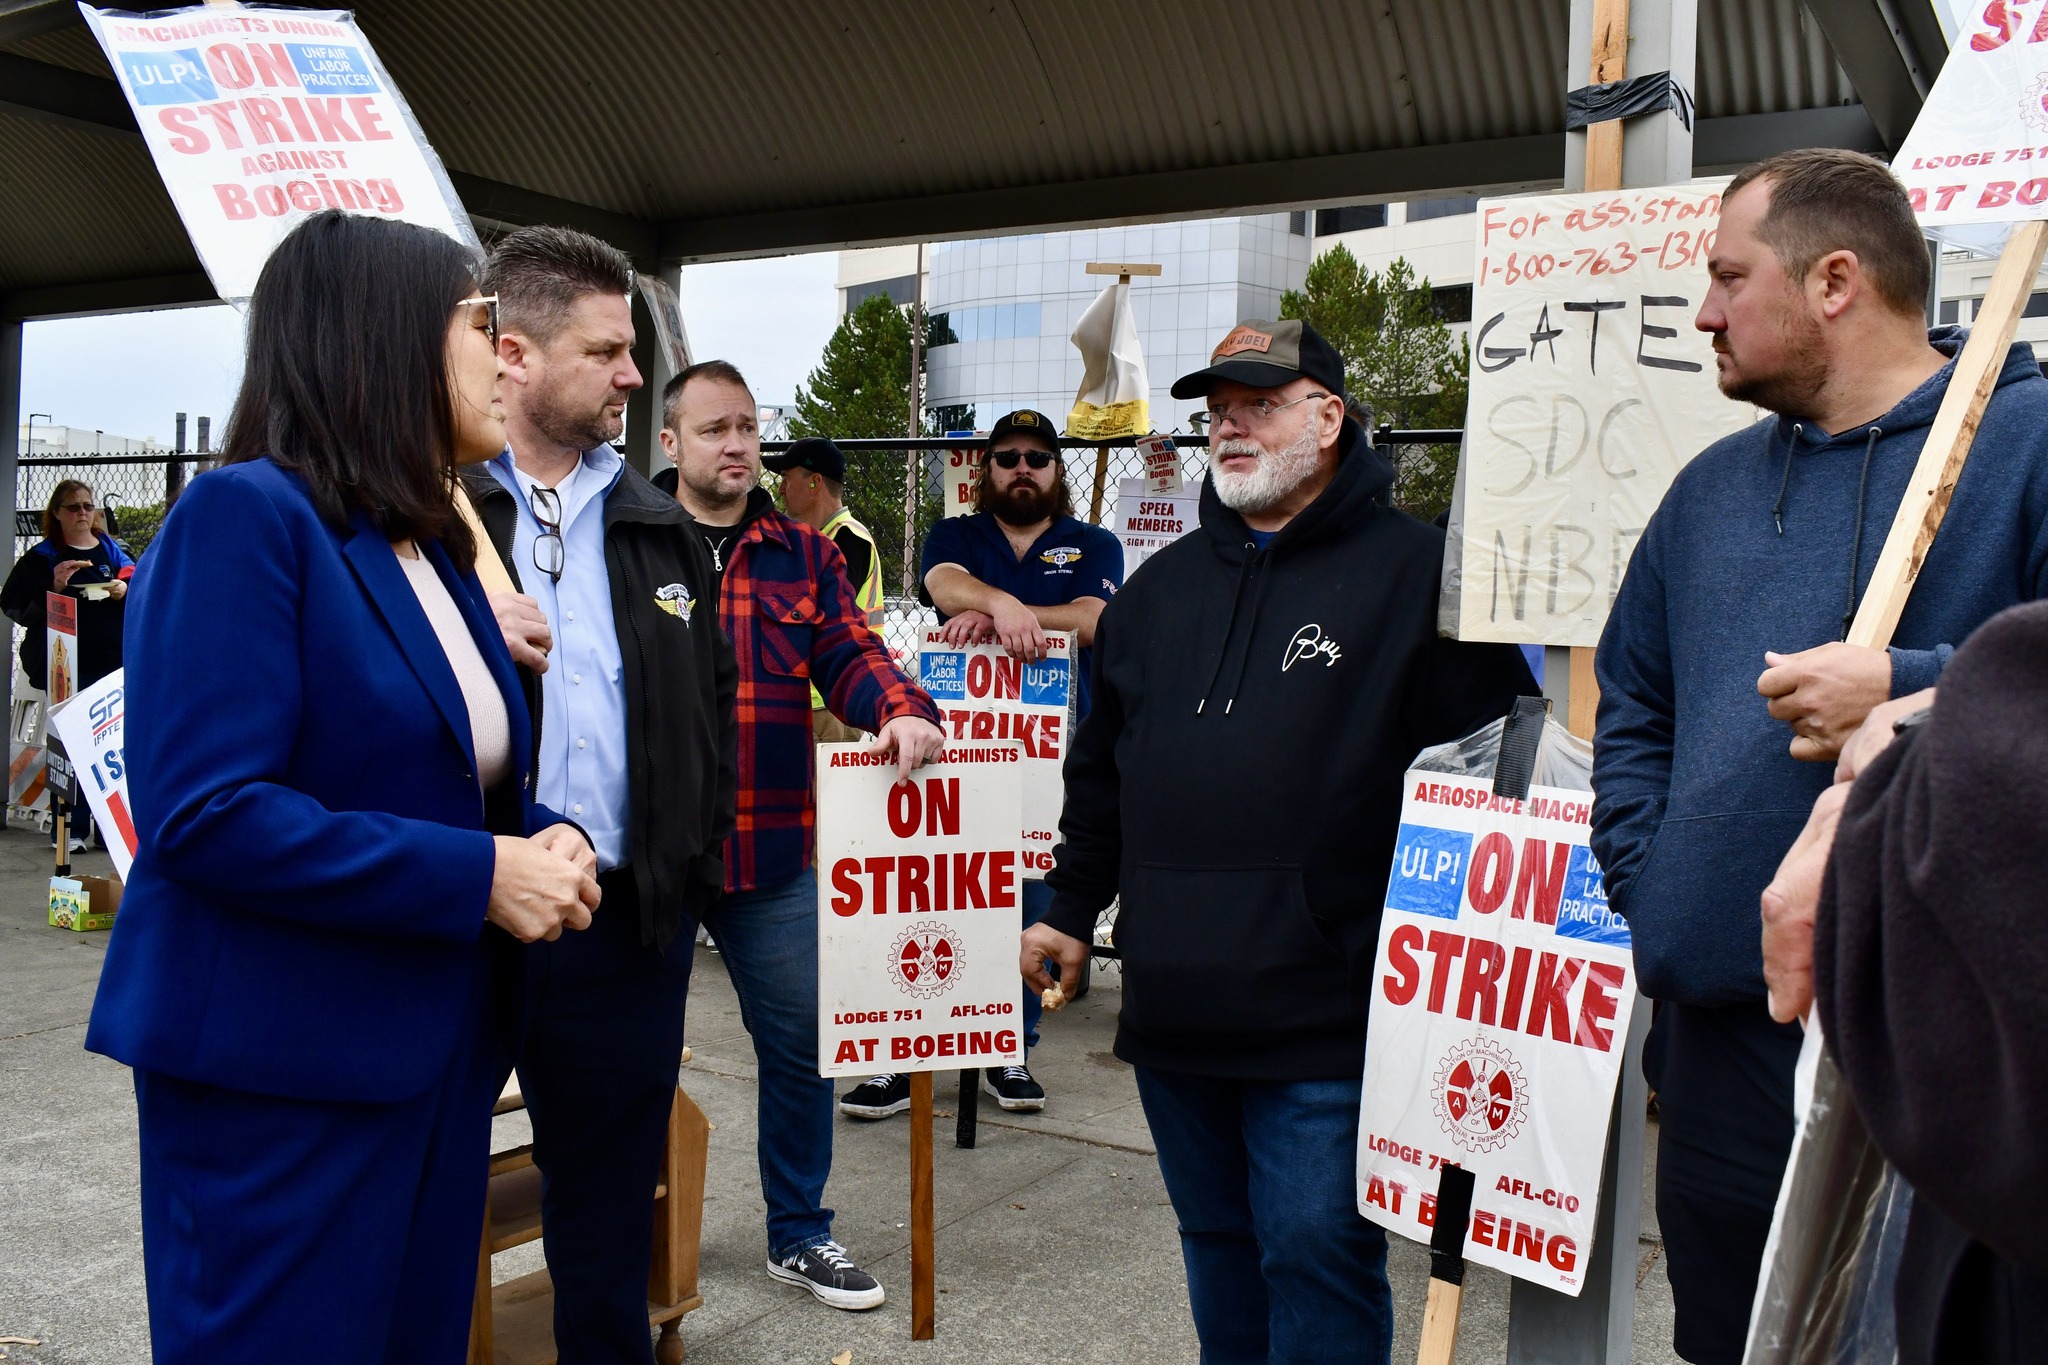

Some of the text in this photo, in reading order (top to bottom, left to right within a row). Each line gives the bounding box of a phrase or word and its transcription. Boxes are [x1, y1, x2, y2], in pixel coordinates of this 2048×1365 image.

[115, 17, 345, 42] MACHINISTS UNION
[301, 47, 349, 60] UNFAIR
[132, 61, 202, 86] ULP!
[205, 43, 301, 90] ON
[310, 61, 354, 73] LABOR
[301, 73, 375, 87] PRACTICES!
[158, 97, 394, 155] STRIKE
[241, 150, 348, 177] AGAINST
[1912, 152, 1996, 170] LODGE
[212, 173, 405, 221] Boeing
[1484, 194, 1722, 247] For assistan
[1237, 335, 1266, 347] JOEL
[1476, 295, 1703, 376] GATE
[1145, 451, 1177, 465] STRIKE
[1151, 442, 1164, 452] ON
[1484, 394, 1643, 497] SDC
[1150, 468, 1174, 479] Boeing
[1139, 502, 1174, 516] SPEEA
[1127, 518, 1183, 533] MEMBERS
[1147, 539, 1155, 547] IN
[929, 655, 957, 666] UNFAIR
[931, 666, 957, 679] LABOR
[921, 680, 964, 692] PRACTICES!
[967, 654, 1021, 700] ON
[1026, 668, 1064, 688] ULP!
[93, 721, 121, 747] IFPTE
[830, 748, 1019, 767] AEROSPA ACHINISTS
[91, 763, 105, 791] I
[887, 777, 960, 838] ON
[1414, 781, 1523, 816] AEROSPACE
[1401, 845, 1461, 886] ULP!
[831, 851, 1016, 917] STRIKE
[1467, 831, 1571, 926] ON
[1383, 924, 1626, 1053] STRIKE
[834, 1002, 1014, 1025] LODGE 751 AFL-CIO
[834, 1029, 1017, 1064] AT BOEING
[1441, 1052, 1466, 1090] ASSOCIATION
[1476, 1048, 1511, 1071] MACHINISTS
[1506, 1086, 1519, 1130] AEROSPACE
[1477, 1128, 1507, 1143] WORKERS
[1368, 1133, 1423, 1166] LODGE
[1495, 1175, 1580, 1214] AFL-CIO
[1365, 1174, 1577, 1273] AT BEING
